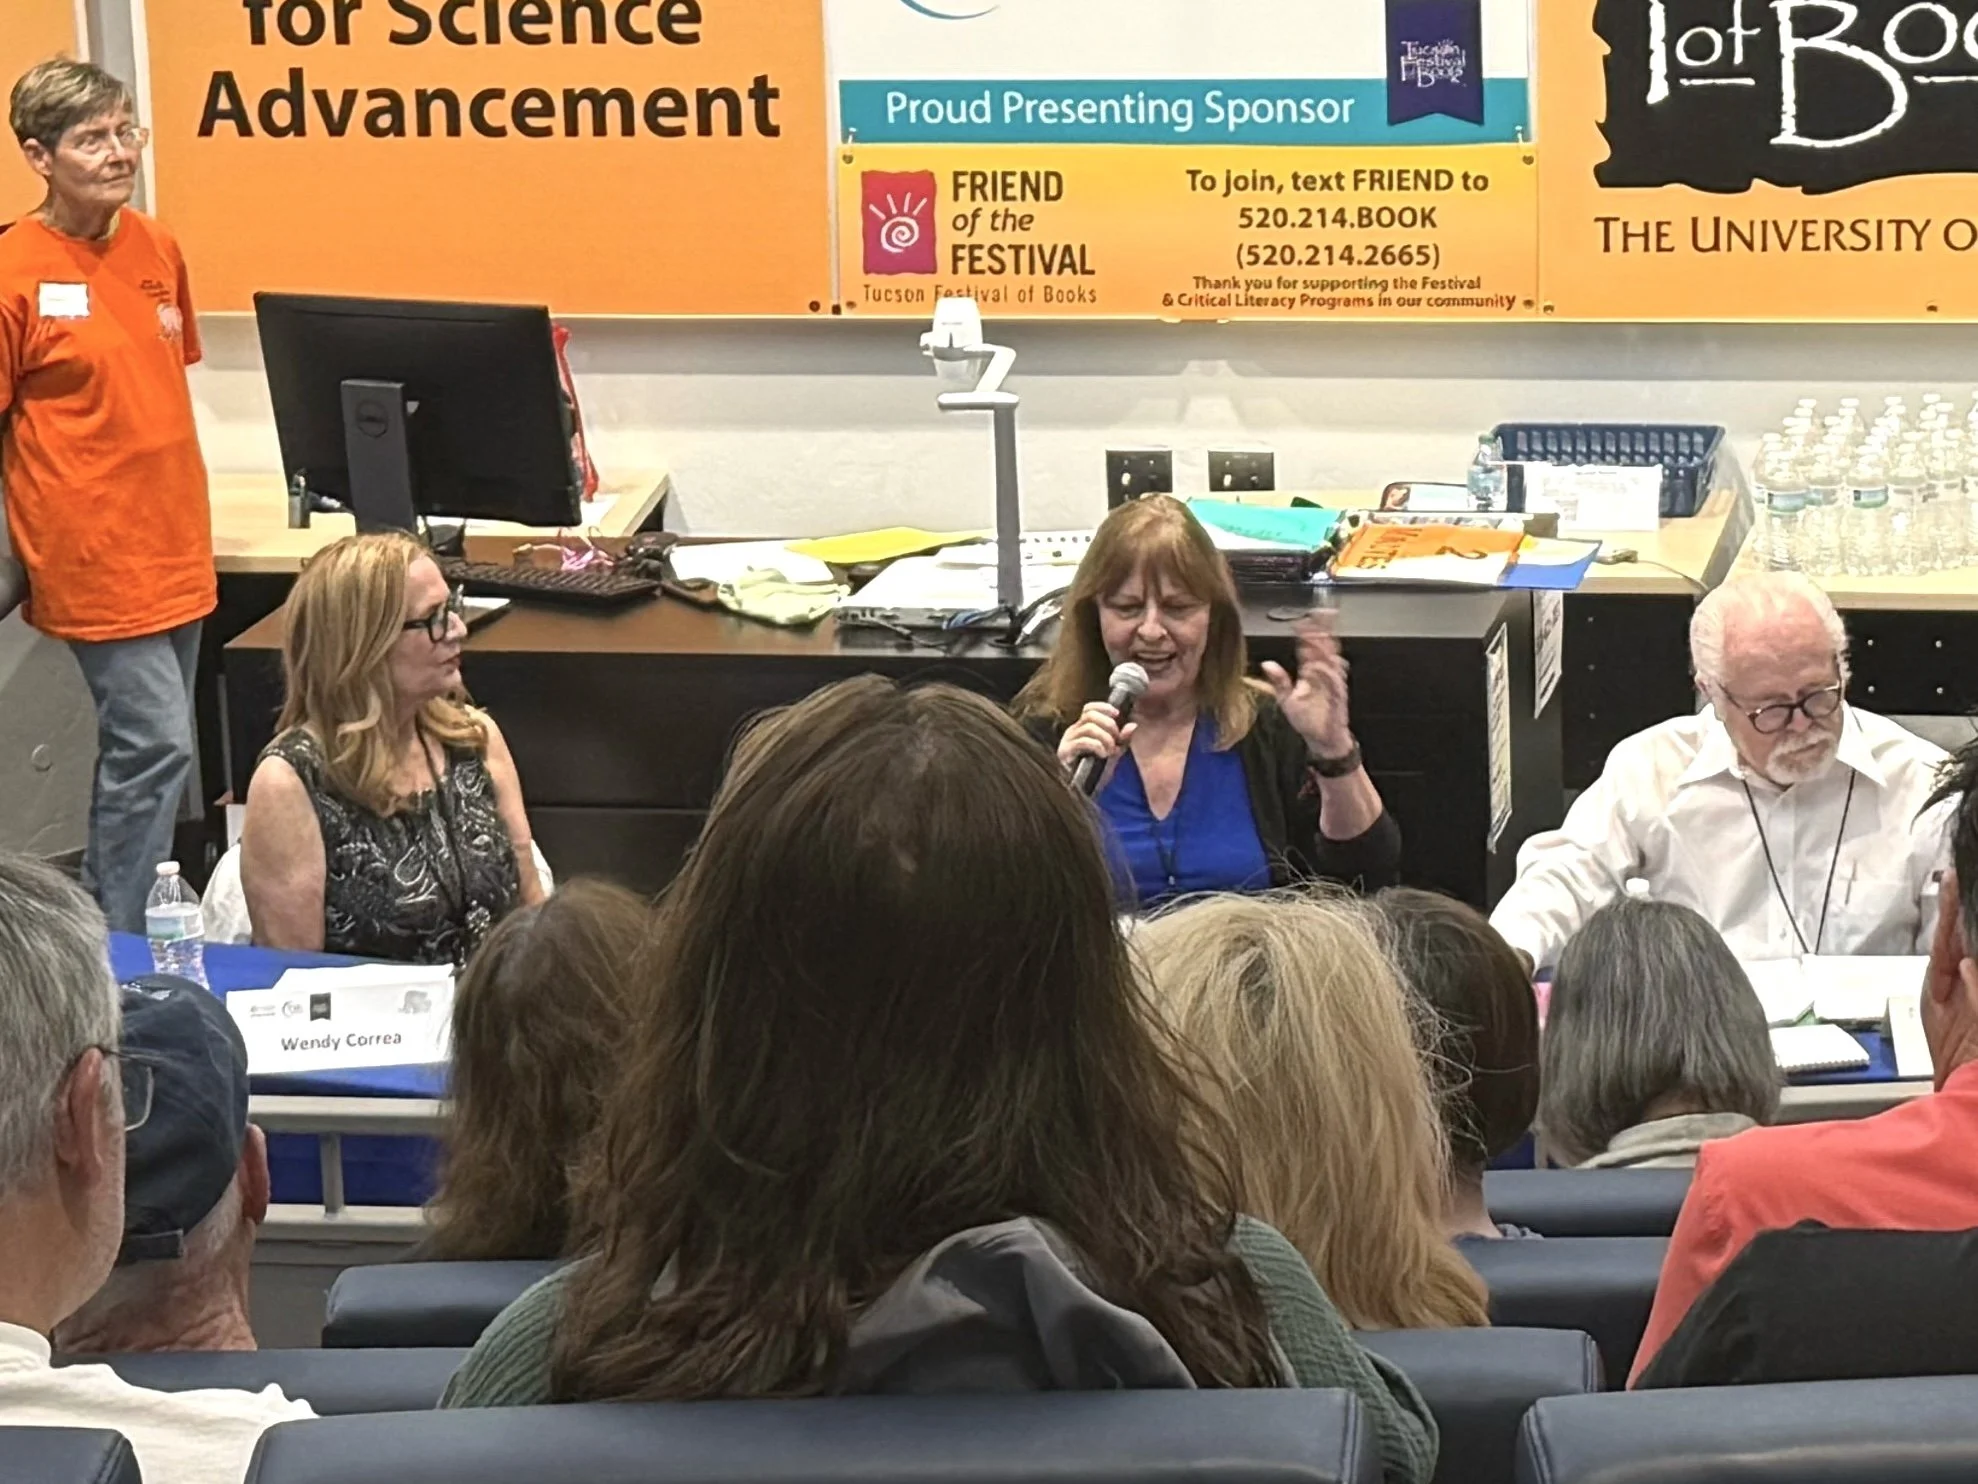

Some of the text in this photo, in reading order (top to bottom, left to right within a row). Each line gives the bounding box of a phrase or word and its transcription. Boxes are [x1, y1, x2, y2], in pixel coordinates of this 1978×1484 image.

[243, 0, 702, 46] for Science
[198, 67, 781, 138] Advancement
[887, 91, 1355, 132] Proud Presenting Sponsor
[952, 171, 1063, 202] FRIEND
[1186, 169, 1489, 197] To join, text FRIEND to
[952, 208, 1035, 237] of the
[1238, 206, 1437, 229] 520.214.BOOK
[1593, 217, 1675, 253] THE
[1691, 217, 1932, 253] UNIVERSITY
[951, 244, 1096, 275] FESTIVAL
[1236, 243, 1440, 270] (520.214.2665)
[863, 284, 1098, 303] Tucson Festival of Books
[1193, 276, 1481, 293] Thank you for supporting the Festival
[1161, 293, 1517, 311] & Critical Literacy Programs in our community
[281, 1033, 402, 1051] Wendy Correa
